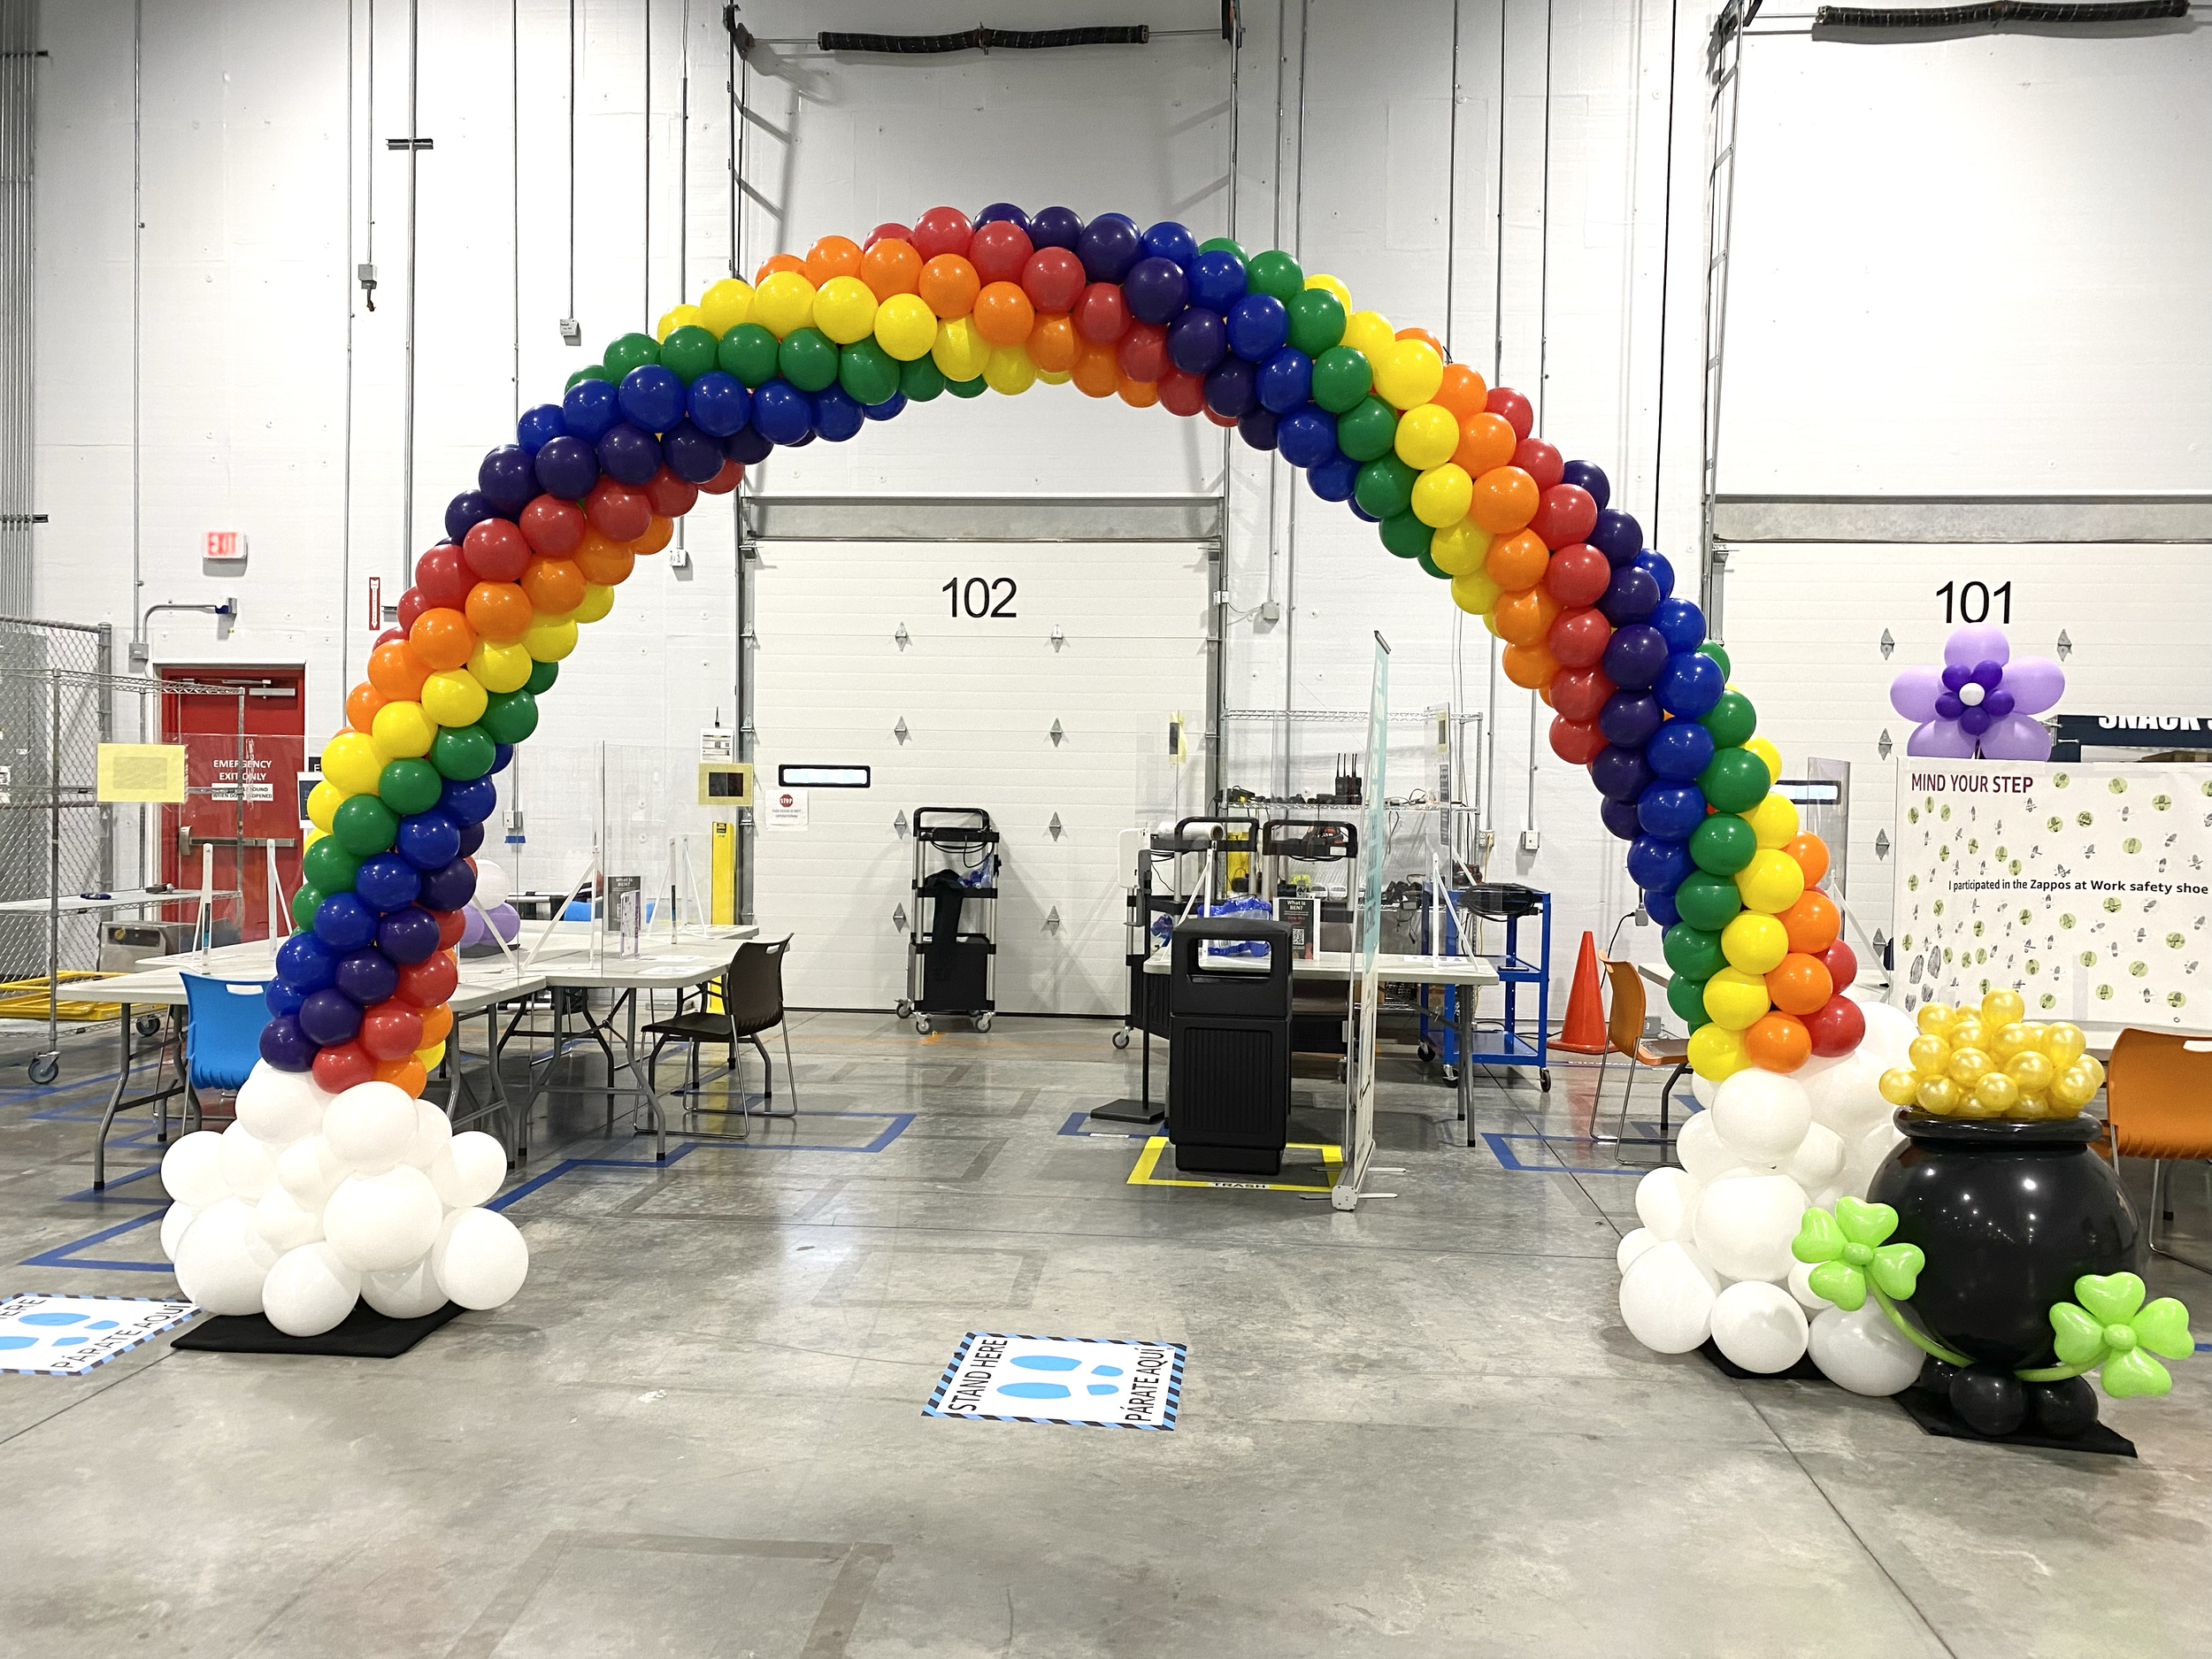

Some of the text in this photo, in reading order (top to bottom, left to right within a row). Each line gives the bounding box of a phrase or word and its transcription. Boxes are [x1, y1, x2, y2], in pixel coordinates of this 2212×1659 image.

[208, 532, 237, 556] EXIT
[942, 577, 1017, 618] 102
[1936, 580, 2011, 624] 101
[1911, 773, 2033, 794] MIND YOUR STEP
[1948, 879, 2208, 895] I participated in the Zappos at Work safety shoe
[0, 1298, 47, 1319] ERE
[948, 1339, 1009, 1412] STAND HERE
[1120, 1348, 1169, 1422] PÁRATE AQUÍ
